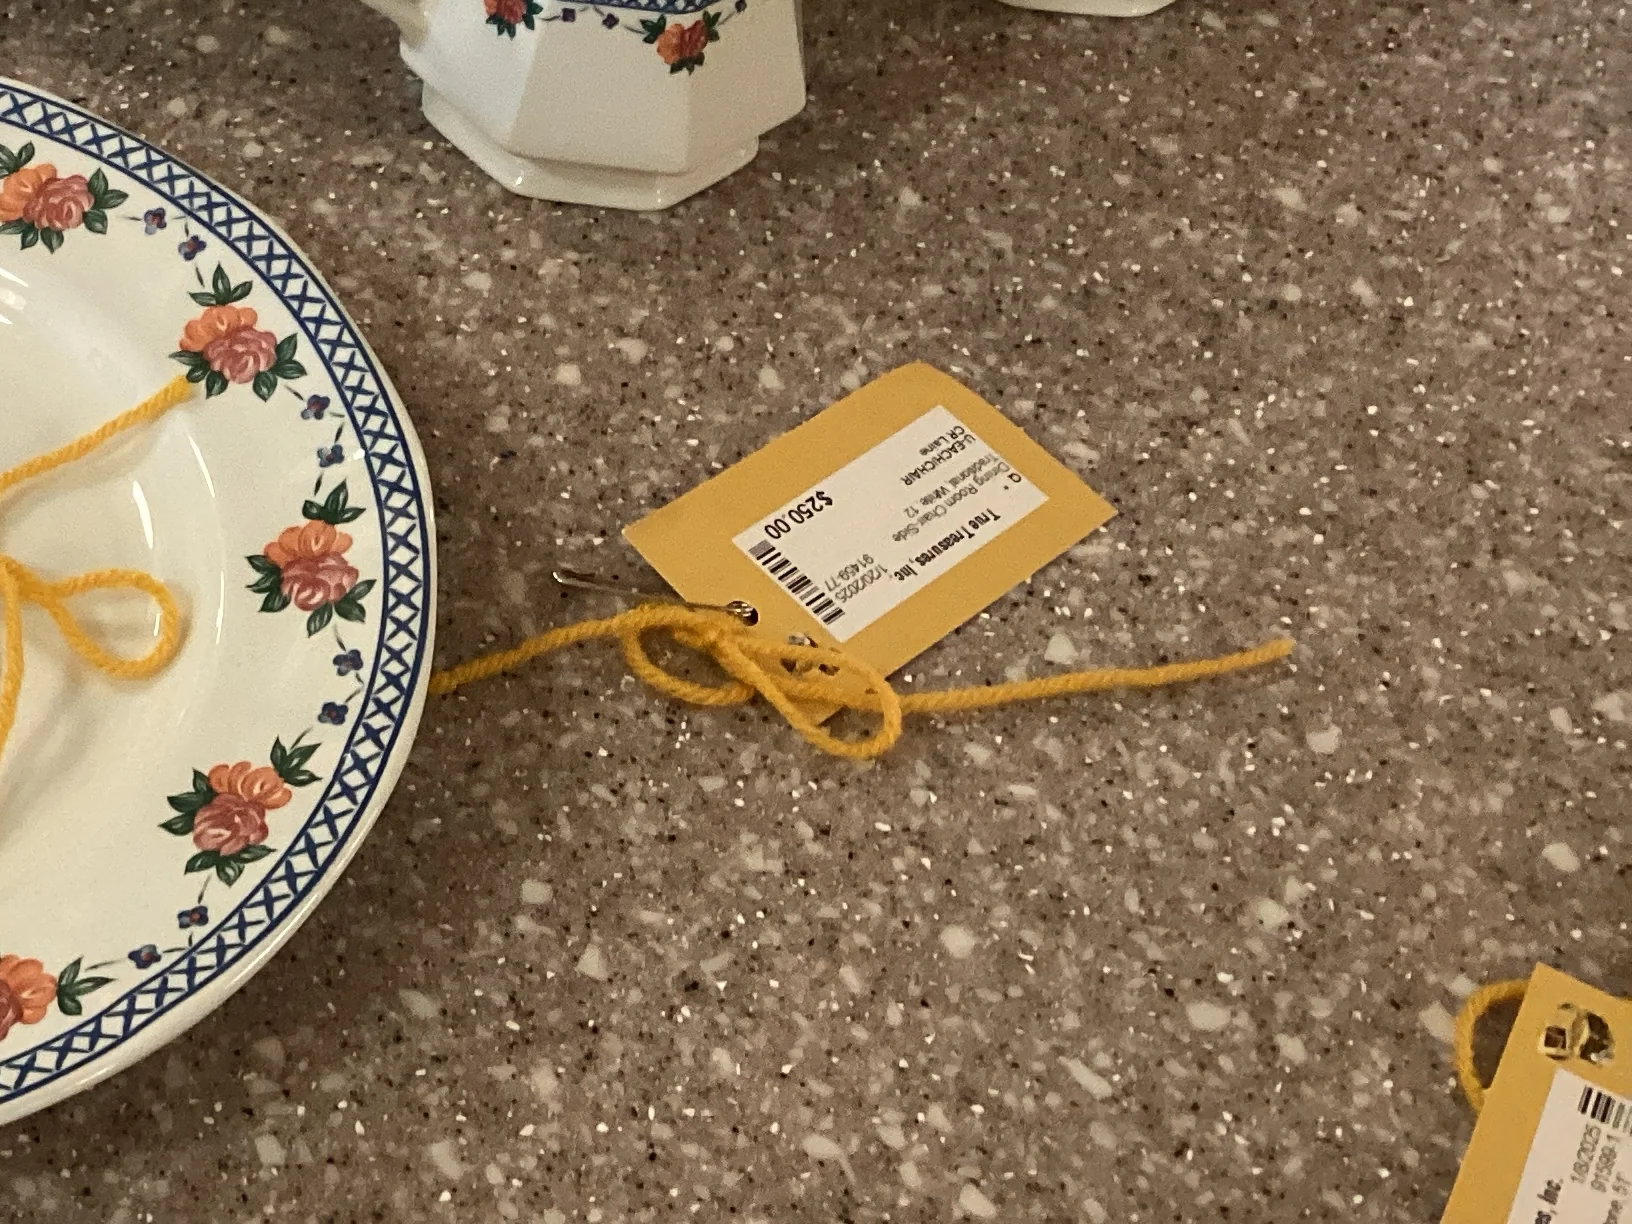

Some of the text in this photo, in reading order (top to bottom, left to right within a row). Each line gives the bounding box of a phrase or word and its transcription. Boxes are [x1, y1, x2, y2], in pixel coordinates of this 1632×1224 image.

[919, 425, 965, 456] CR Laine
[972, 461, 1011, 486] Dining
[1006, 472, 1022, 484] Q
[944, 484, 979, 507] Room
[764, 491, 834, 540] $250.00
[968, 507, 1002, 530] True
[908, 525, 976, 567] Treasures,
